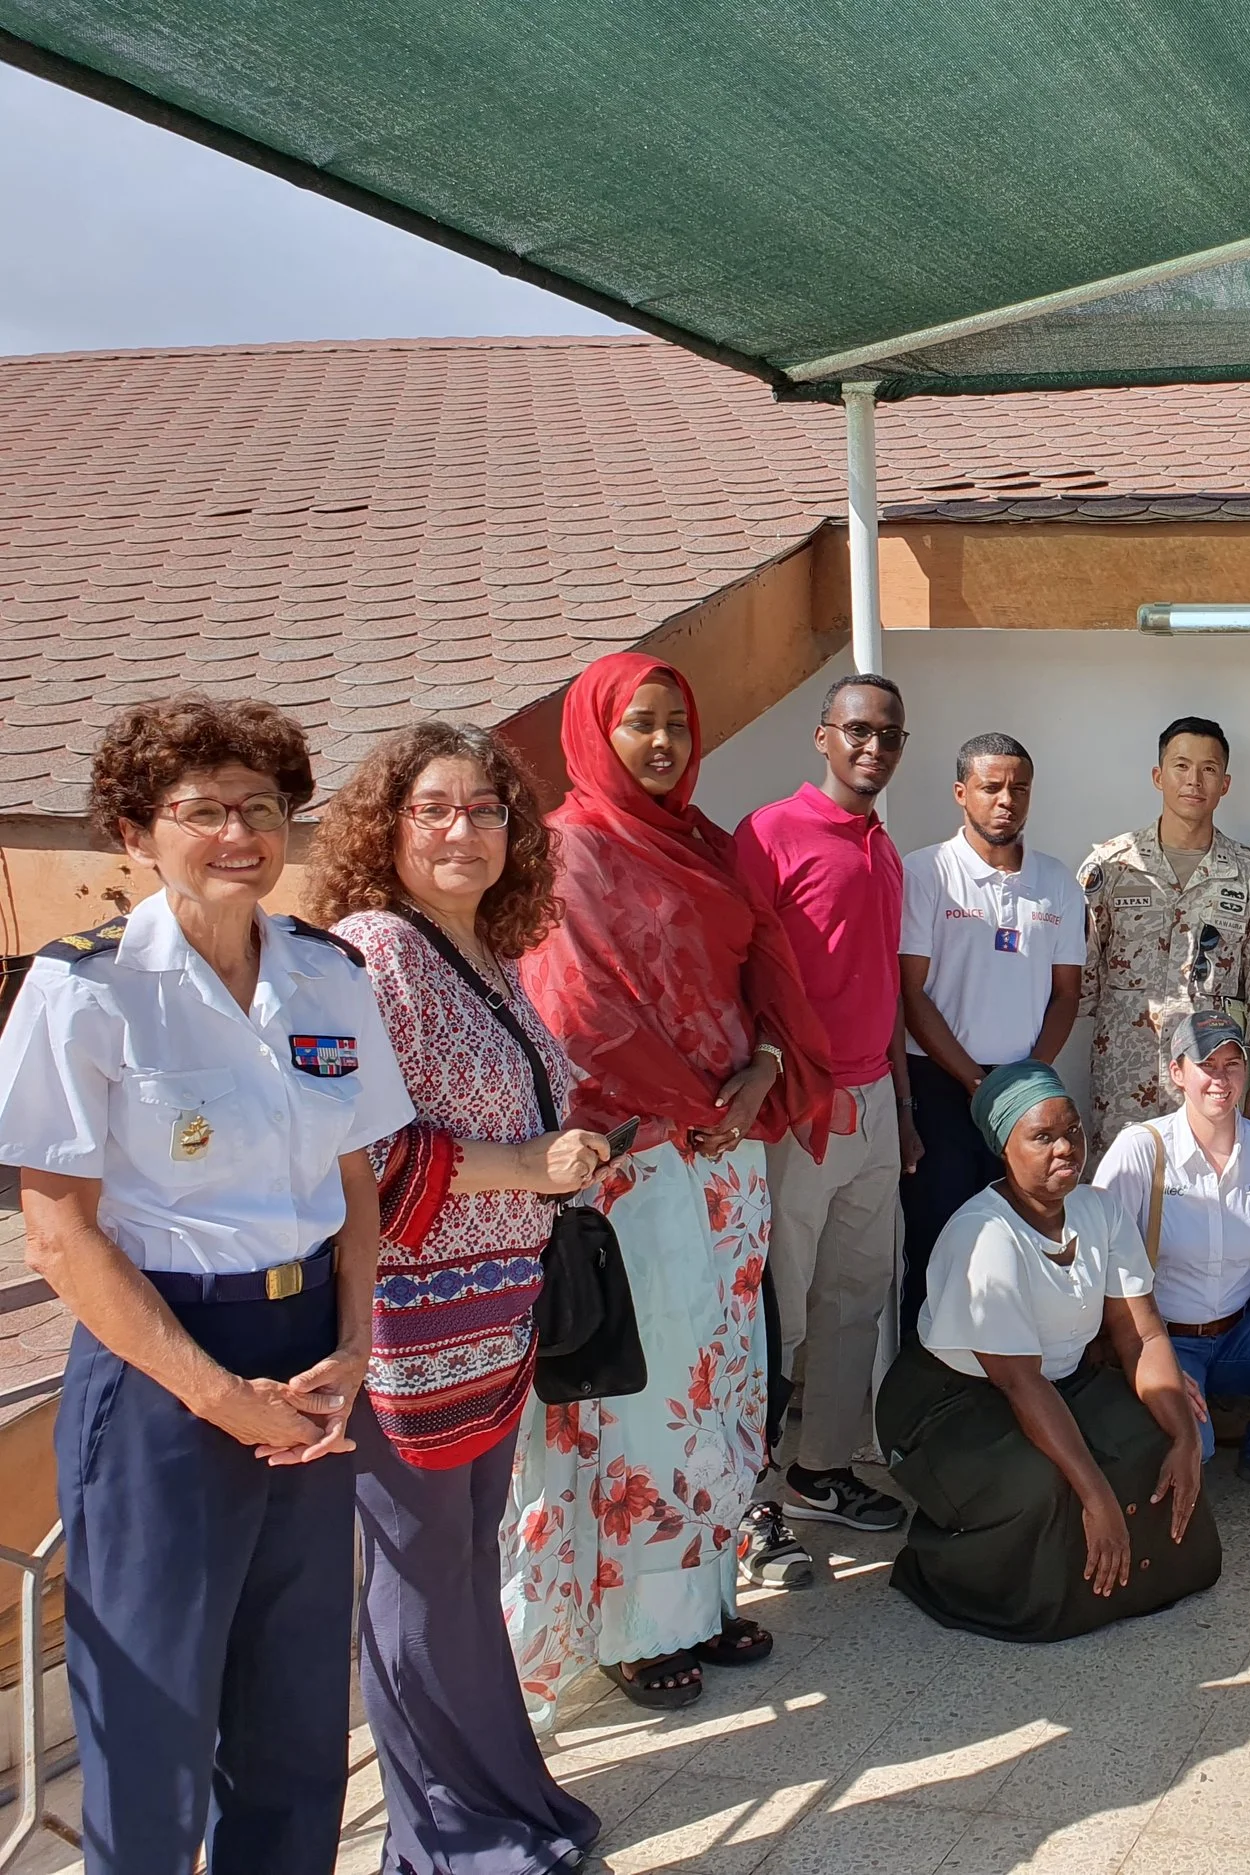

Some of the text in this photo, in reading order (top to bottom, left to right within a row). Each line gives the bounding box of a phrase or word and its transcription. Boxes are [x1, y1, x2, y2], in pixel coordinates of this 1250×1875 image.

[1115, 898, 1149, 906] JAPAN
[945, 908, 985, 919] POLICE
[1164, 1185, 1185, 1197] itec
